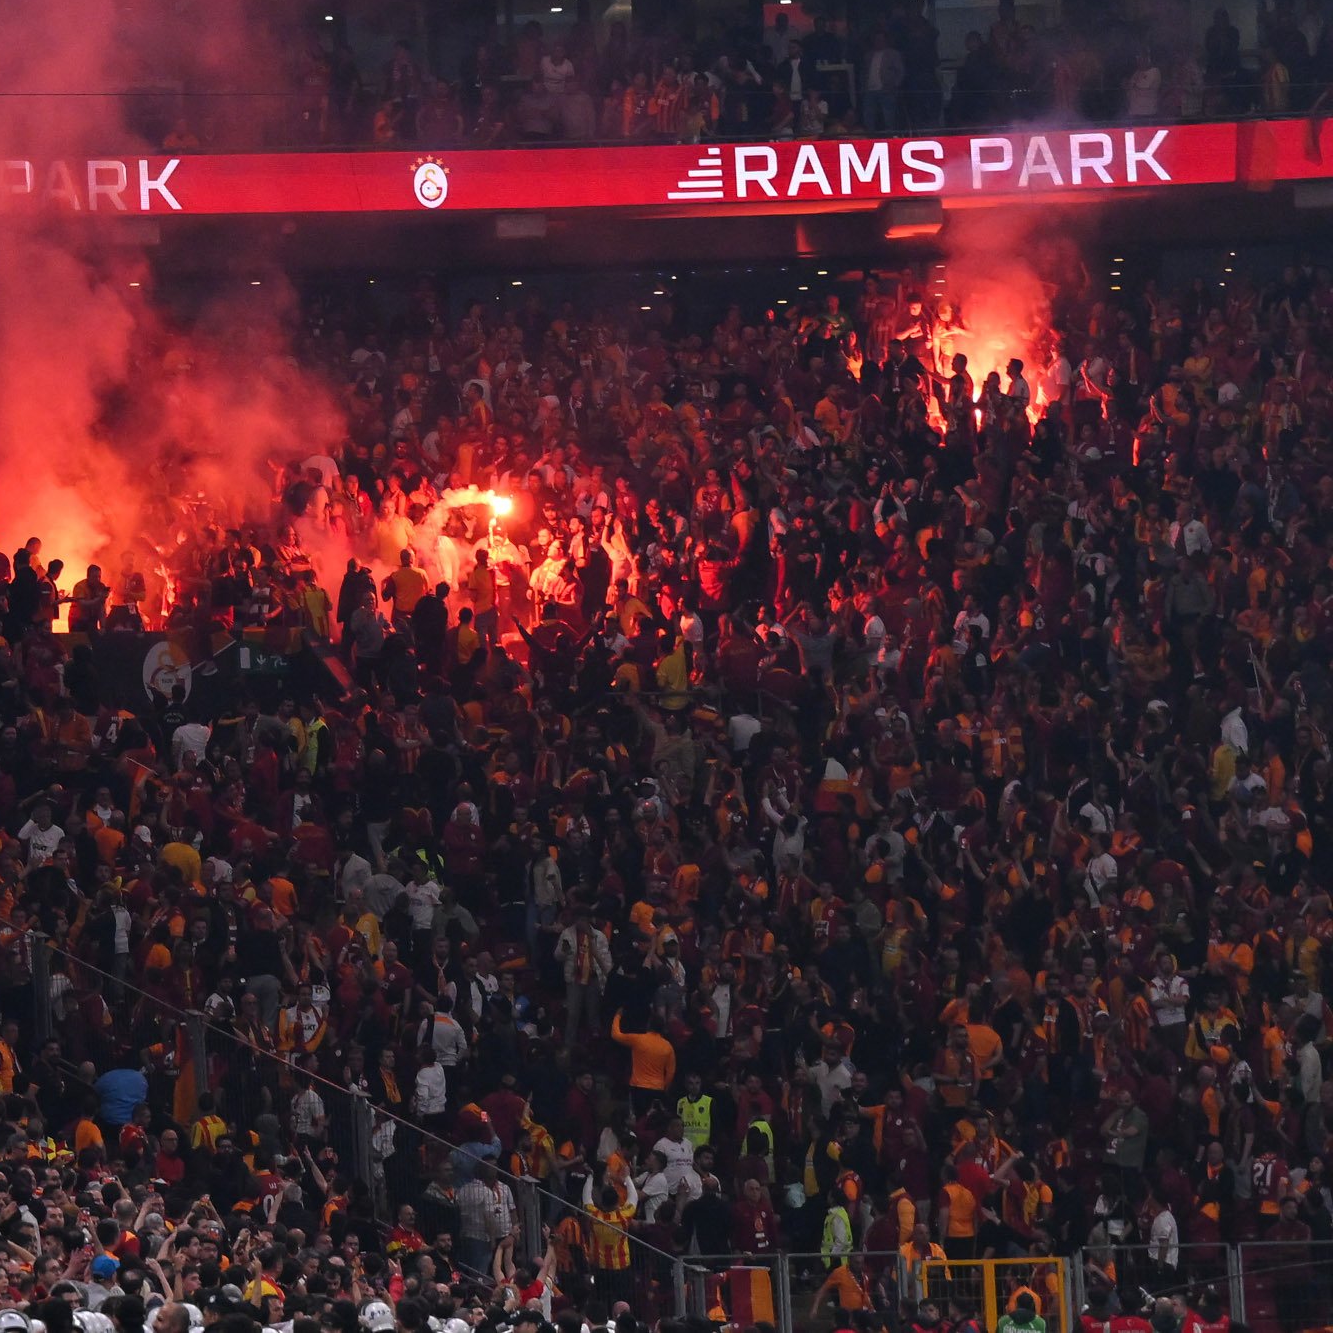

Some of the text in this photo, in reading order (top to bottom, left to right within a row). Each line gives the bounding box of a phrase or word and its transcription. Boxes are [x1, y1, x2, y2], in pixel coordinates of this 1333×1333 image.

[735, 130, 1171, 197] RAMS PARK
[1252, 1162, 1273, 1187] 21
